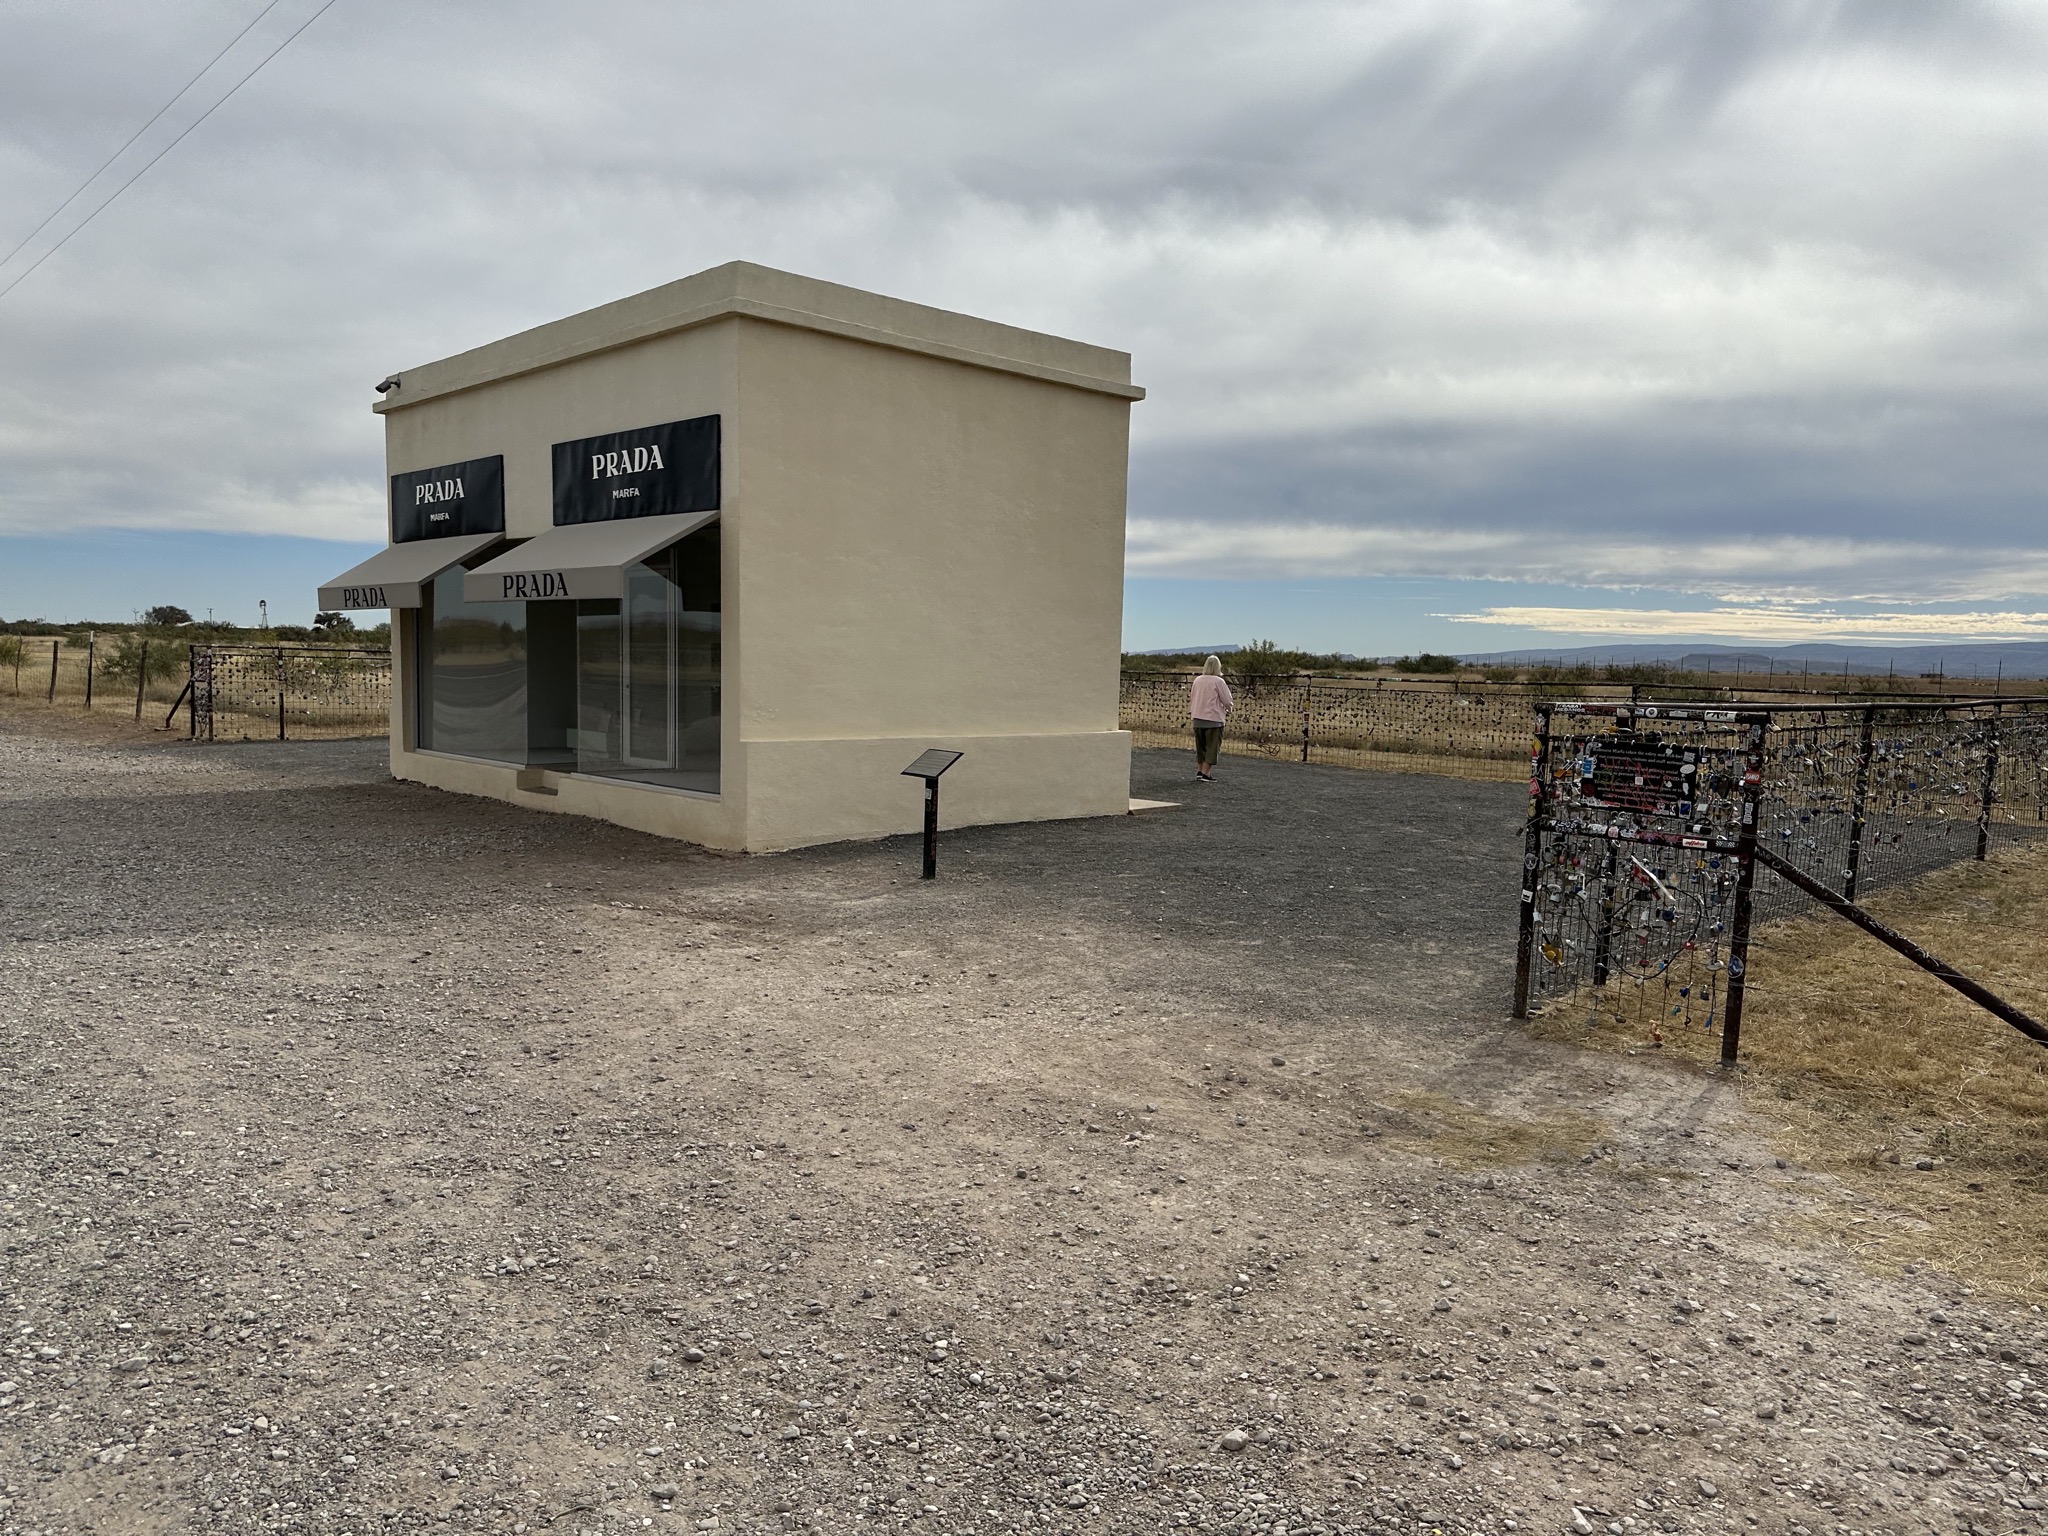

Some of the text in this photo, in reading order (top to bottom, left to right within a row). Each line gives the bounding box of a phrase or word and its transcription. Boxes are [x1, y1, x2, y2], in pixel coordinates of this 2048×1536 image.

[591, 444, 665, 480] PRADA
[415, 478, 465, 506] PRADA
[612, 487, 641, 499] MARFA
[429, 511, 450, 522] MARFA
[343, 586, 388, 608] PRADA
[503, 572, 569, 598] PRADA
